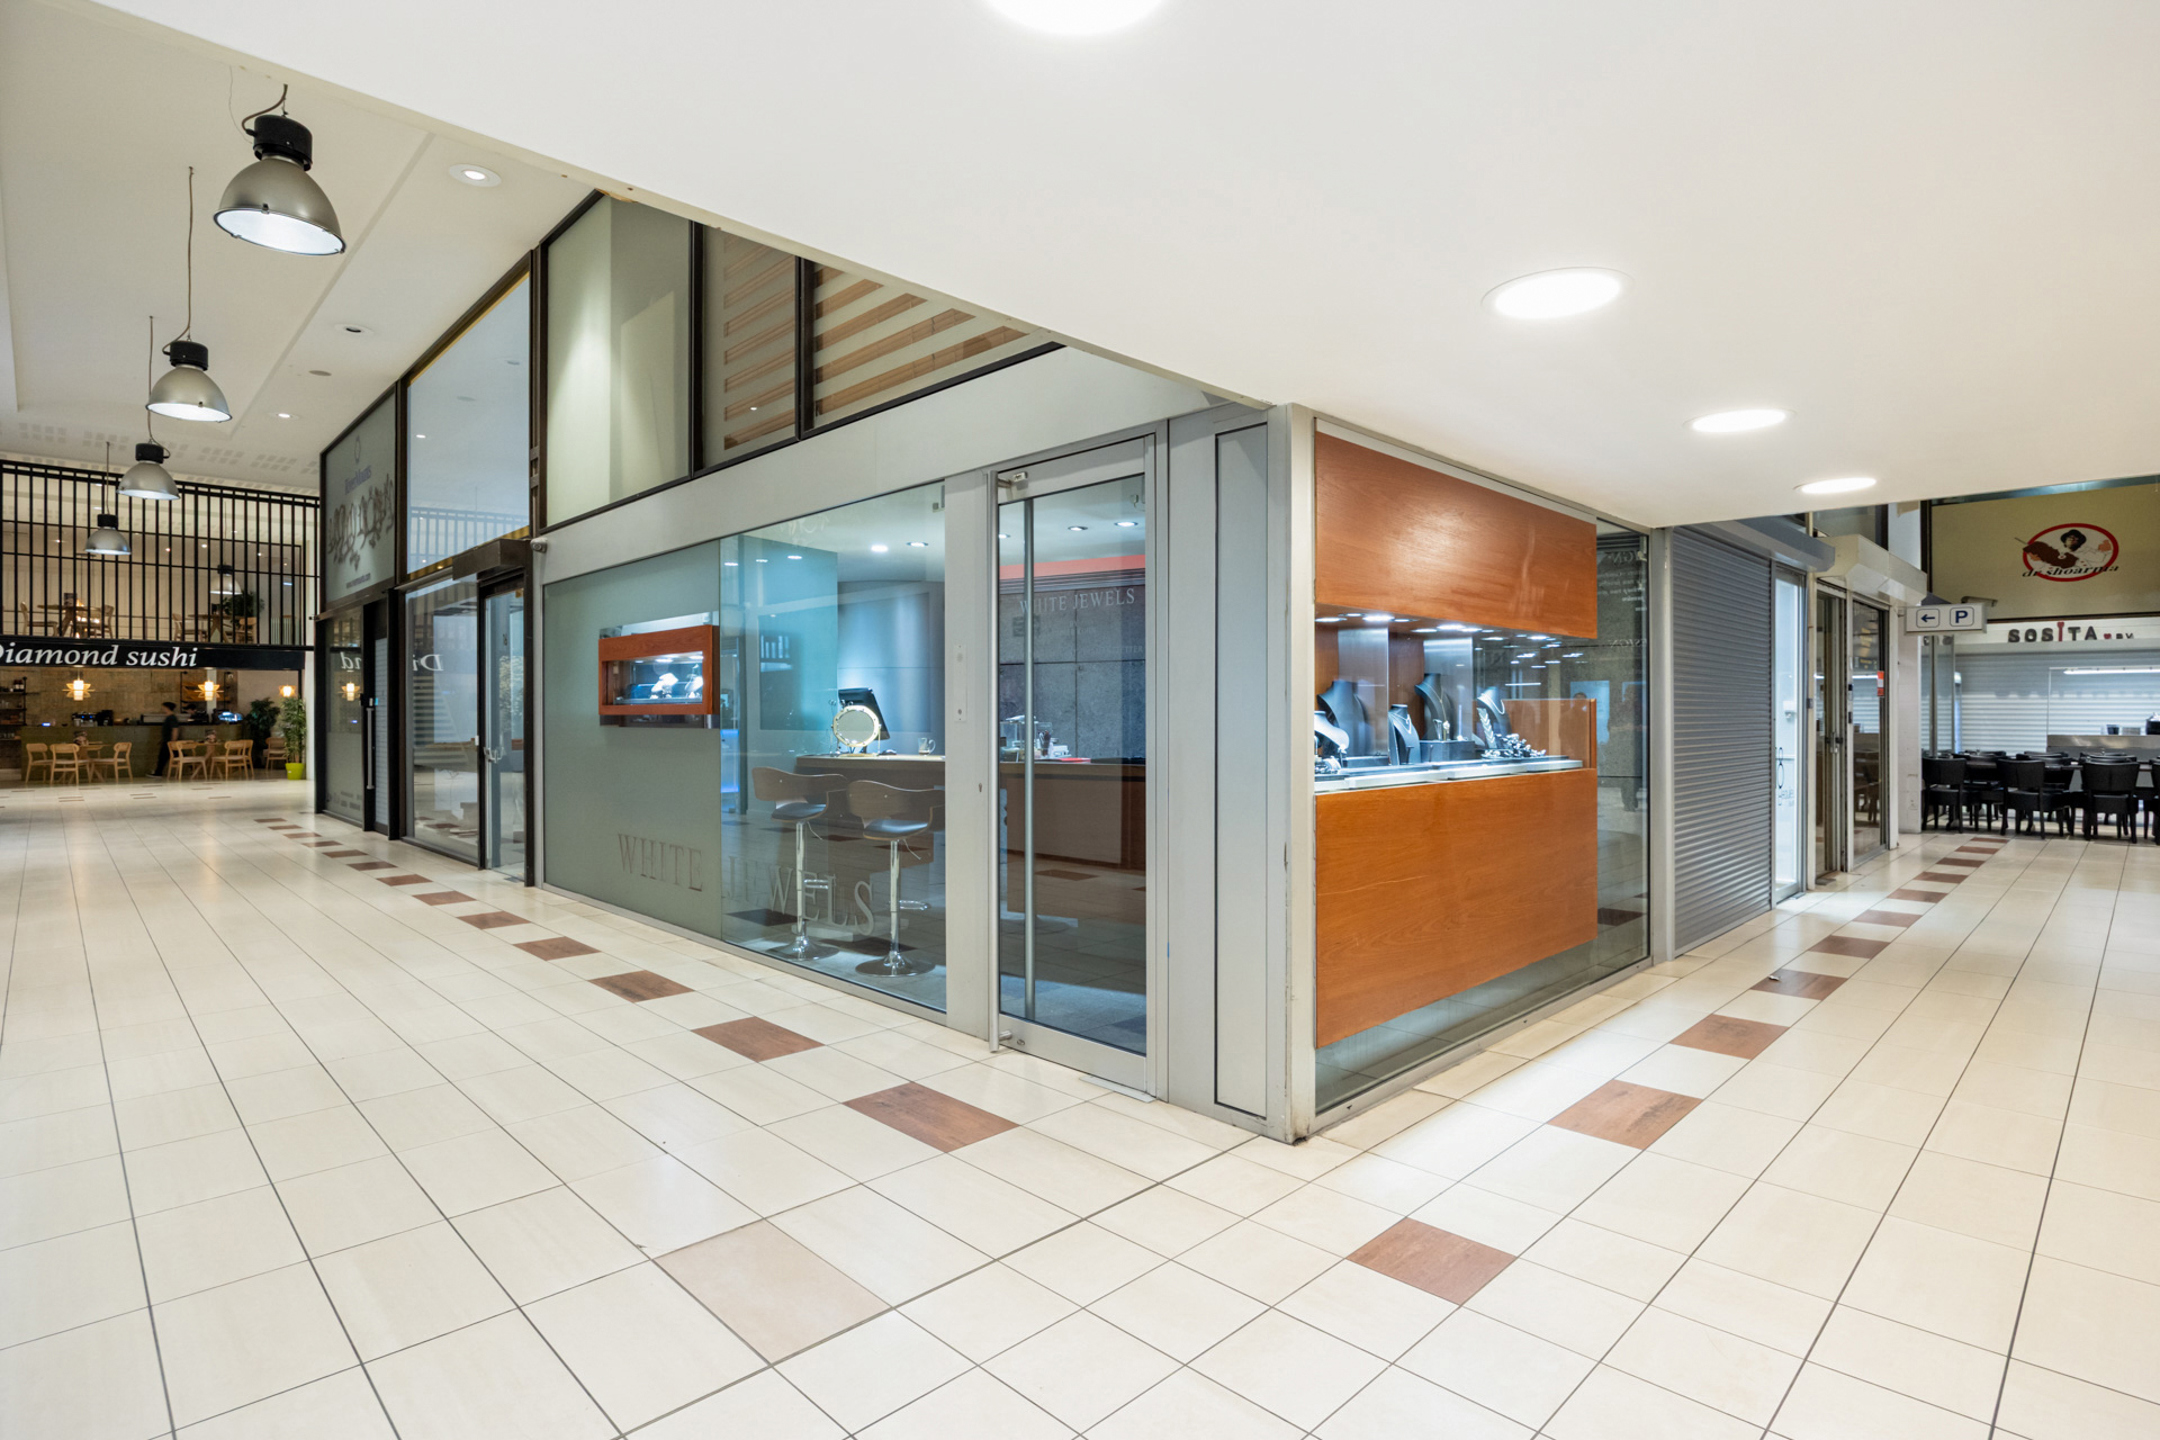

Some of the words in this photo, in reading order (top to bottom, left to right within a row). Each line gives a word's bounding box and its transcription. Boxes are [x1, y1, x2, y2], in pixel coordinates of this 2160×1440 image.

[1073, 587, 1135, 610] JEWELS
[1955, 610, 1968, 624] P
[2008, 621, 2098, 643] SOSITA
[0, 642, 119, 666] iamond
[126, 646, 198, 667] sushi
[618, 833, 703, 893] WHITE
[721, 855, 875, 936] JEWELS
